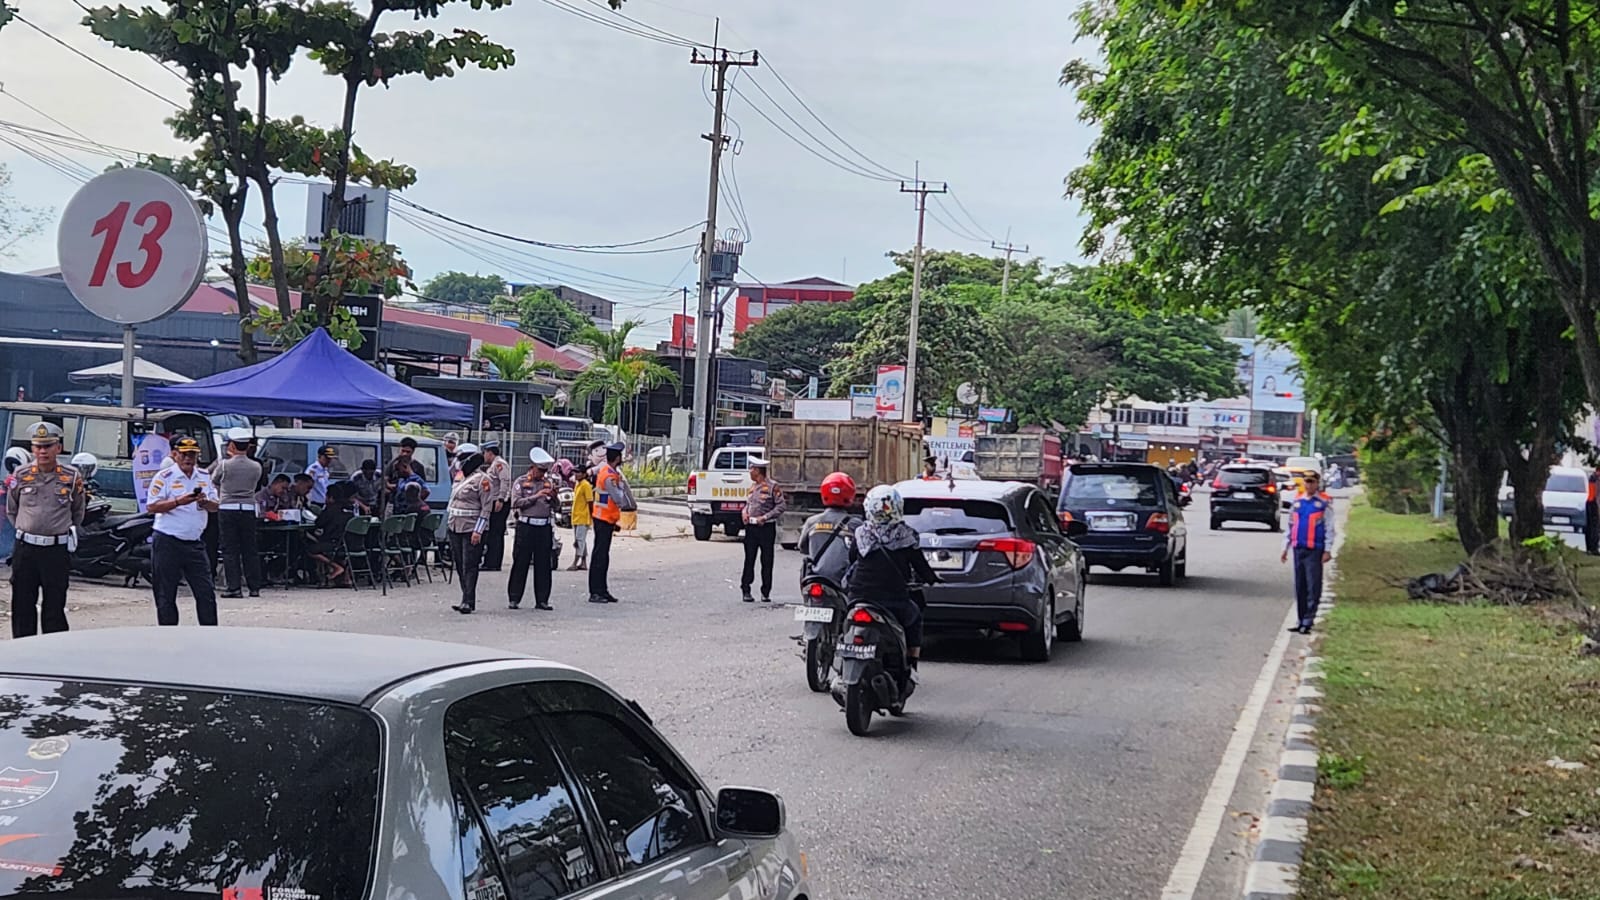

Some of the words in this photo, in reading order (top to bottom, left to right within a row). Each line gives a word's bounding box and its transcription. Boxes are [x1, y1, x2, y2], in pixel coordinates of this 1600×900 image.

[88, 201, 173, 288] 13
[1214, 413, 1243, 423] TIKI
[930, 442, 975, 451] ENTLEMEN
[271, 892, 321, 900] OTOMOTIF
